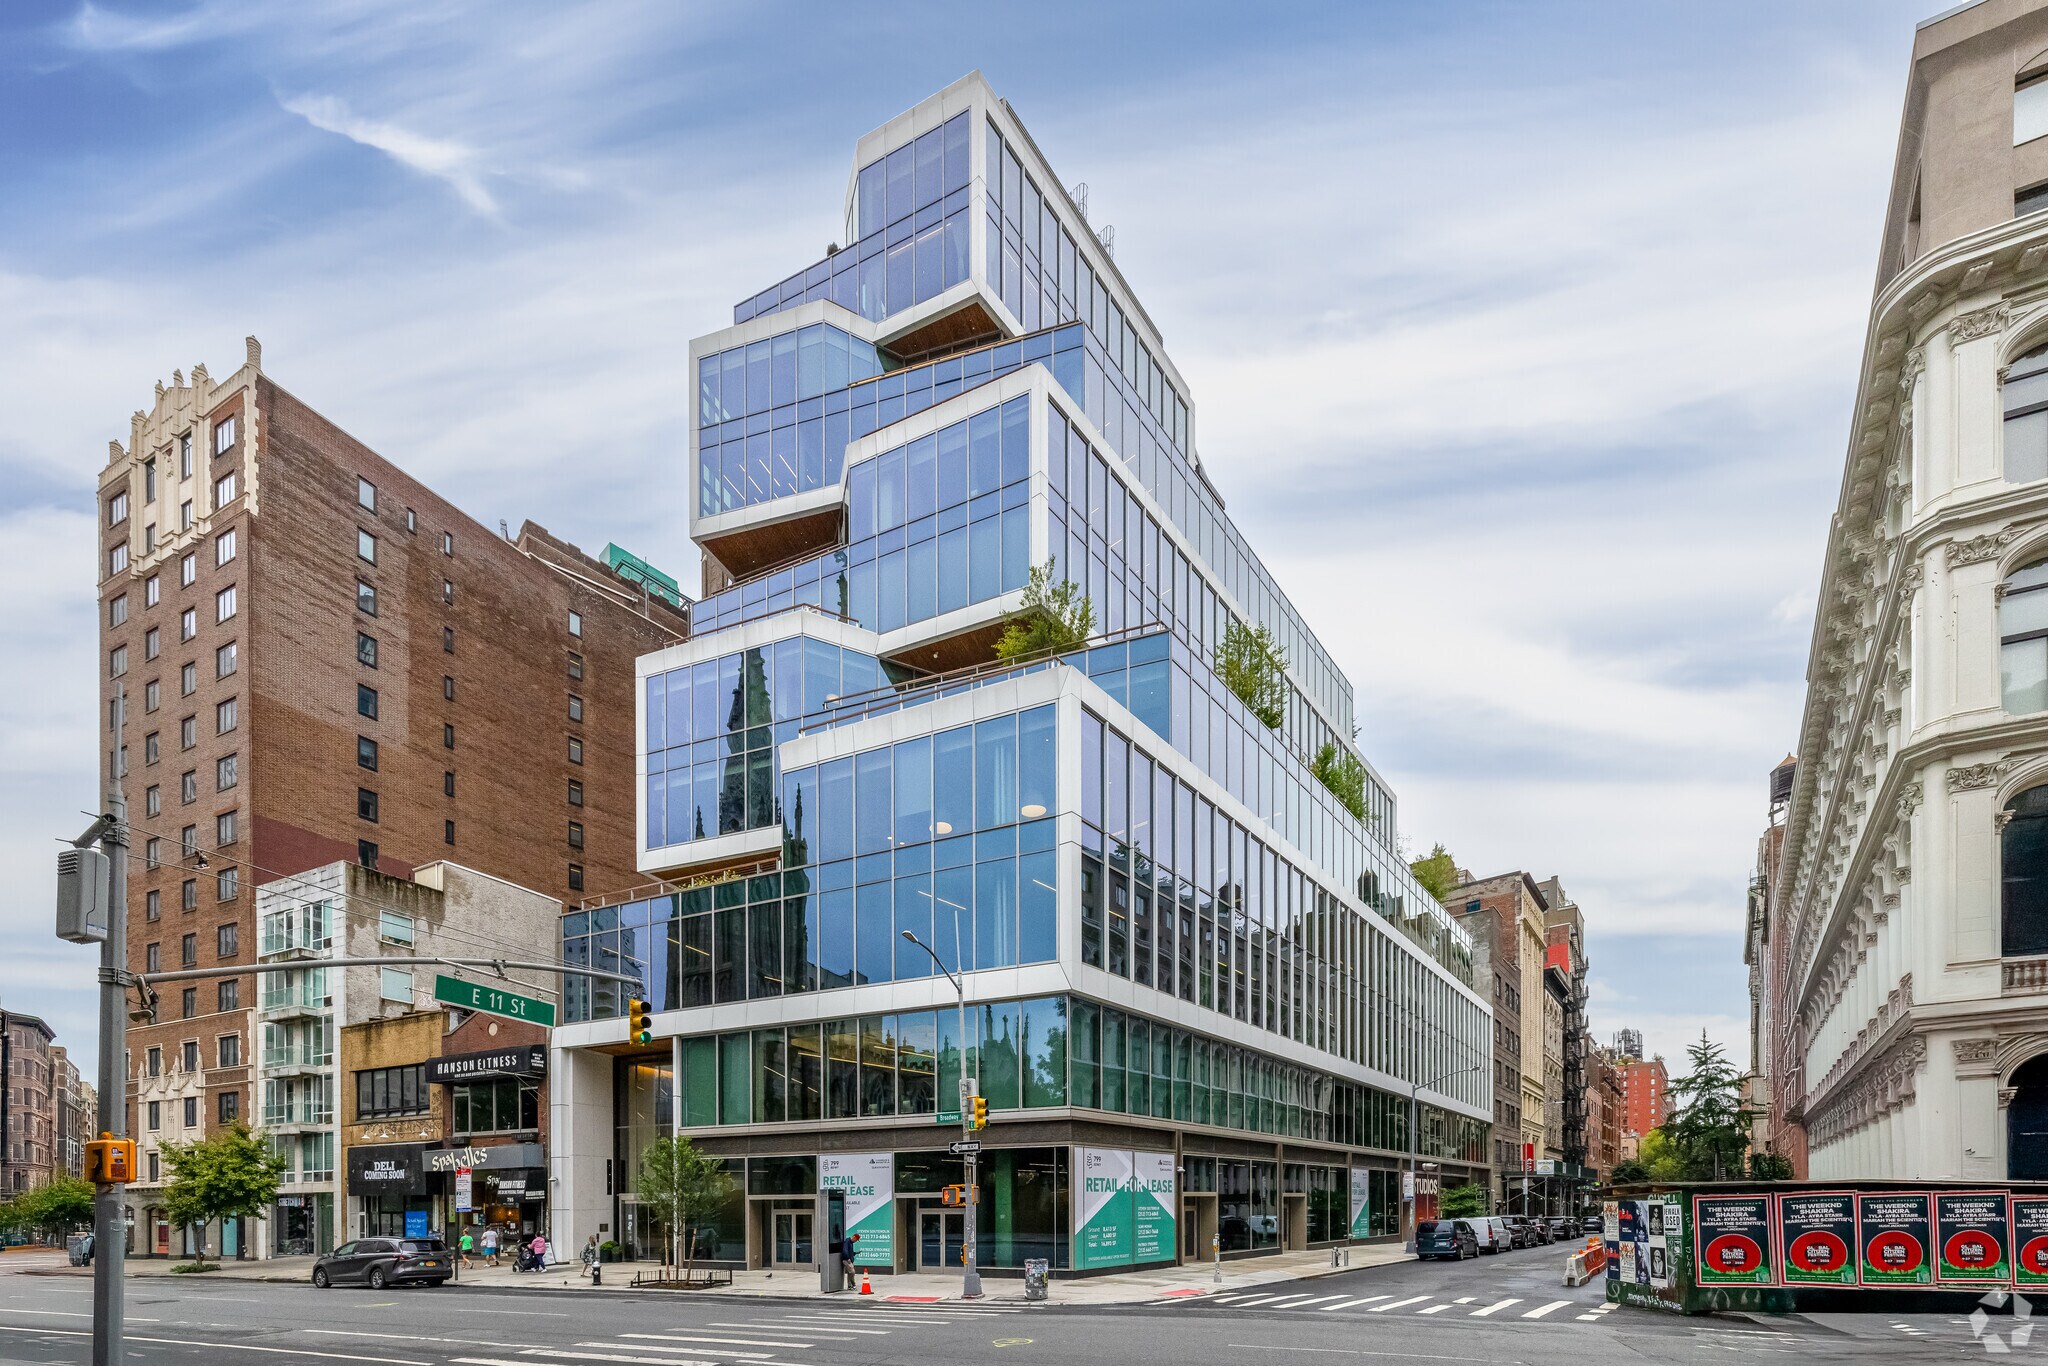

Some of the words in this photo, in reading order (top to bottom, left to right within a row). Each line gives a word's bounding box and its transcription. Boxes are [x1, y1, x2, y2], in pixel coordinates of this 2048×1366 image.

[472, 988, 480, 1004] E
[490, 993, 502, 1010] 11
[510, 998, 526, 1016] St
[437, 1060, 475, 1074] HANSON
[478, 1055, 517, 1070] FITNESS
[432, 1146, 488, 1172] Spabelles
[374, 1161, 395, 1171] DELI
[364, 1170, 388, 1180] COMING
[388, 1169, 405, 1180] SOON
[823, 1176, 856, 1185] RETAIL
[1086, 1177, 1118, 1192] RETAIL
[1124, 1180, 1143, 1192] FOR
[1146, 1180, 1172, 1193] LEASE
[1665, 1216, 1680, 1226] OSED
